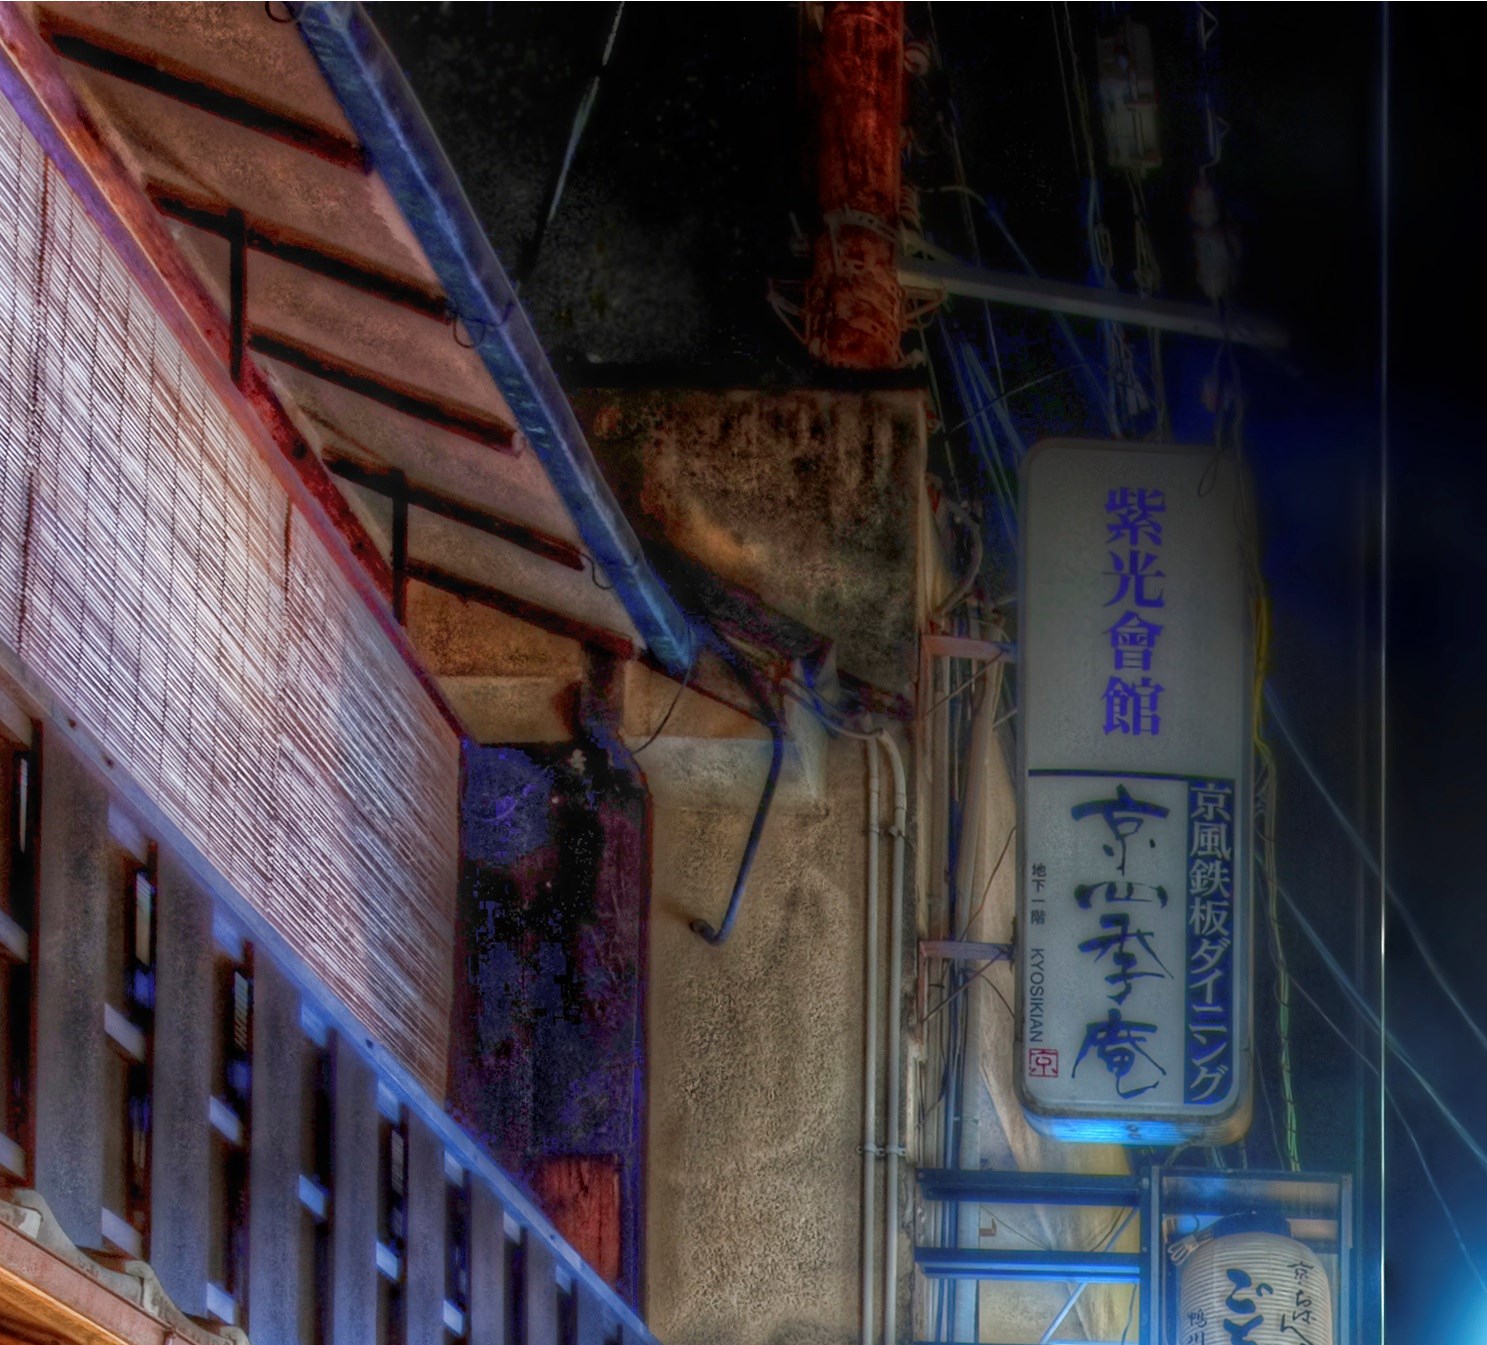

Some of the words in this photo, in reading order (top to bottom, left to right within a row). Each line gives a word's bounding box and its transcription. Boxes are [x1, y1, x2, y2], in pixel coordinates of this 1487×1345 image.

[1102, 487, 1166, 736] 紫光會館
[1030, 948, 1044, 1042] KYOSIKIAN
[1189, 783, 1232, 1102] 京風鉄板ダイニング
